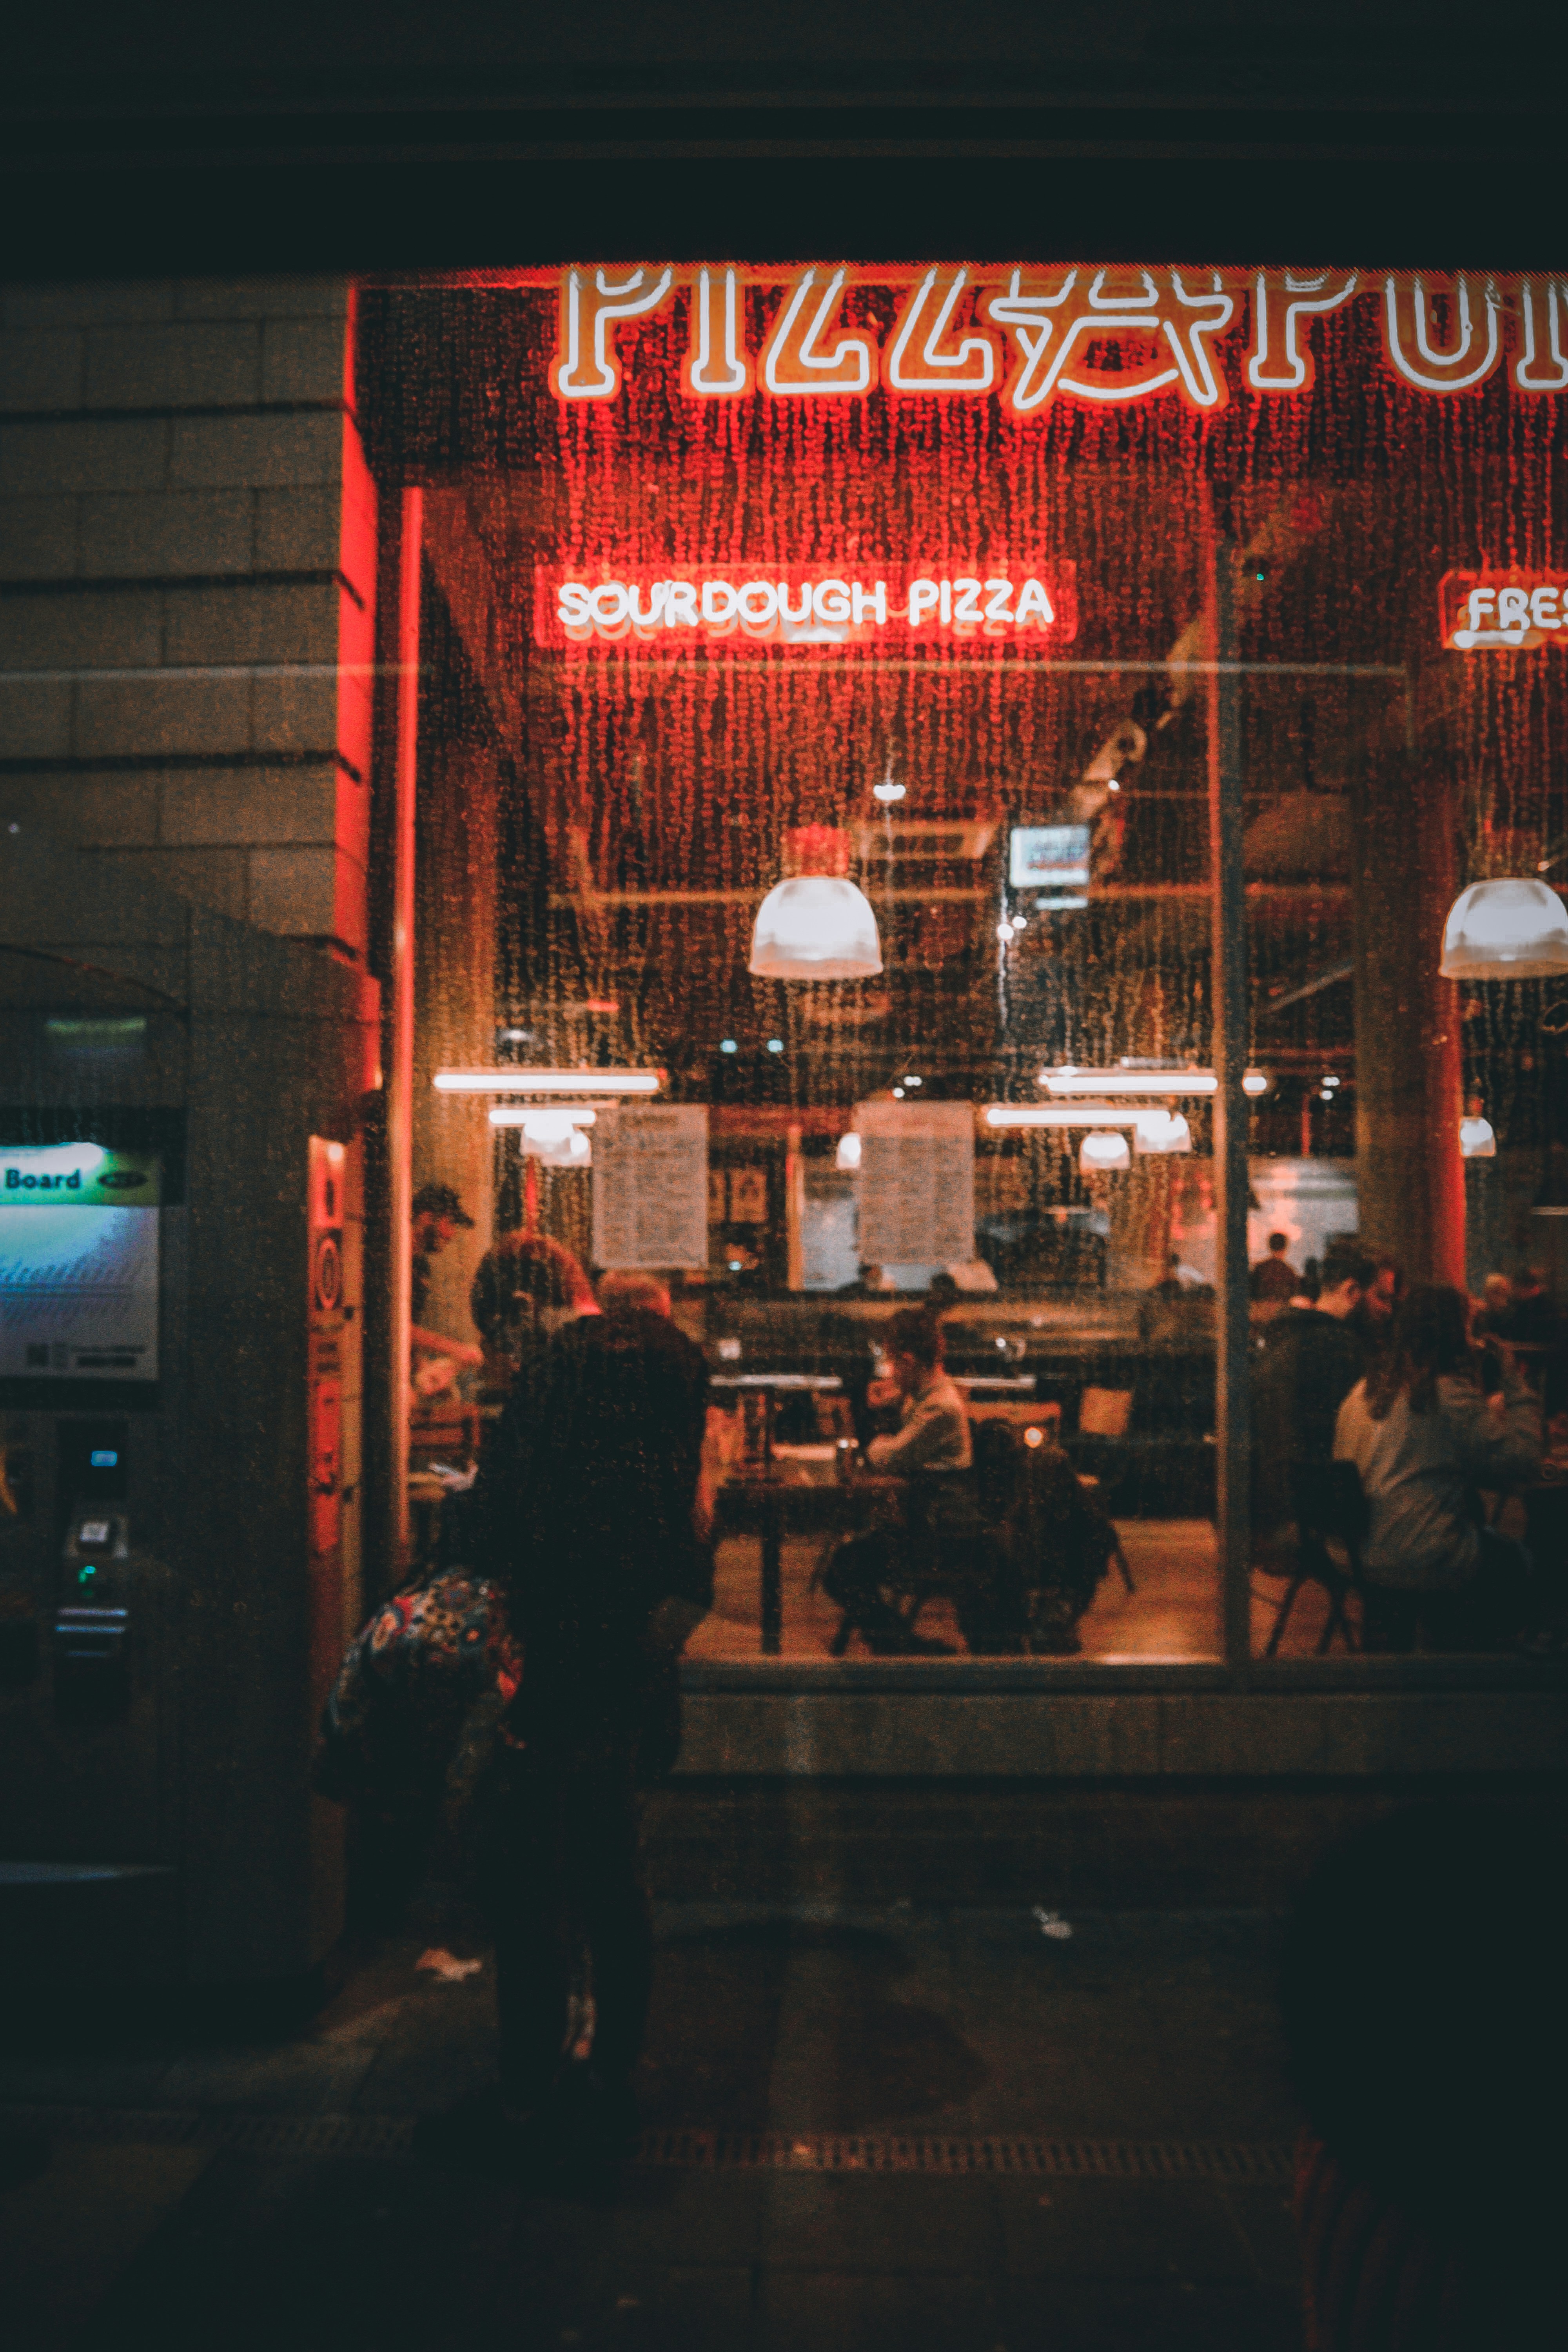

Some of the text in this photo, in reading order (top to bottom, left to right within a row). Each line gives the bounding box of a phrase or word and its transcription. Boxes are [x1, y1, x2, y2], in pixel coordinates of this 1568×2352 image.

[1249, 268, 1568, 392] PU
[558, 579, 1054, 627] SOURDOUGH PIZZA
[1468, 587, 1568, 630] FRE
[5, 1169, 81, 1189] Board
